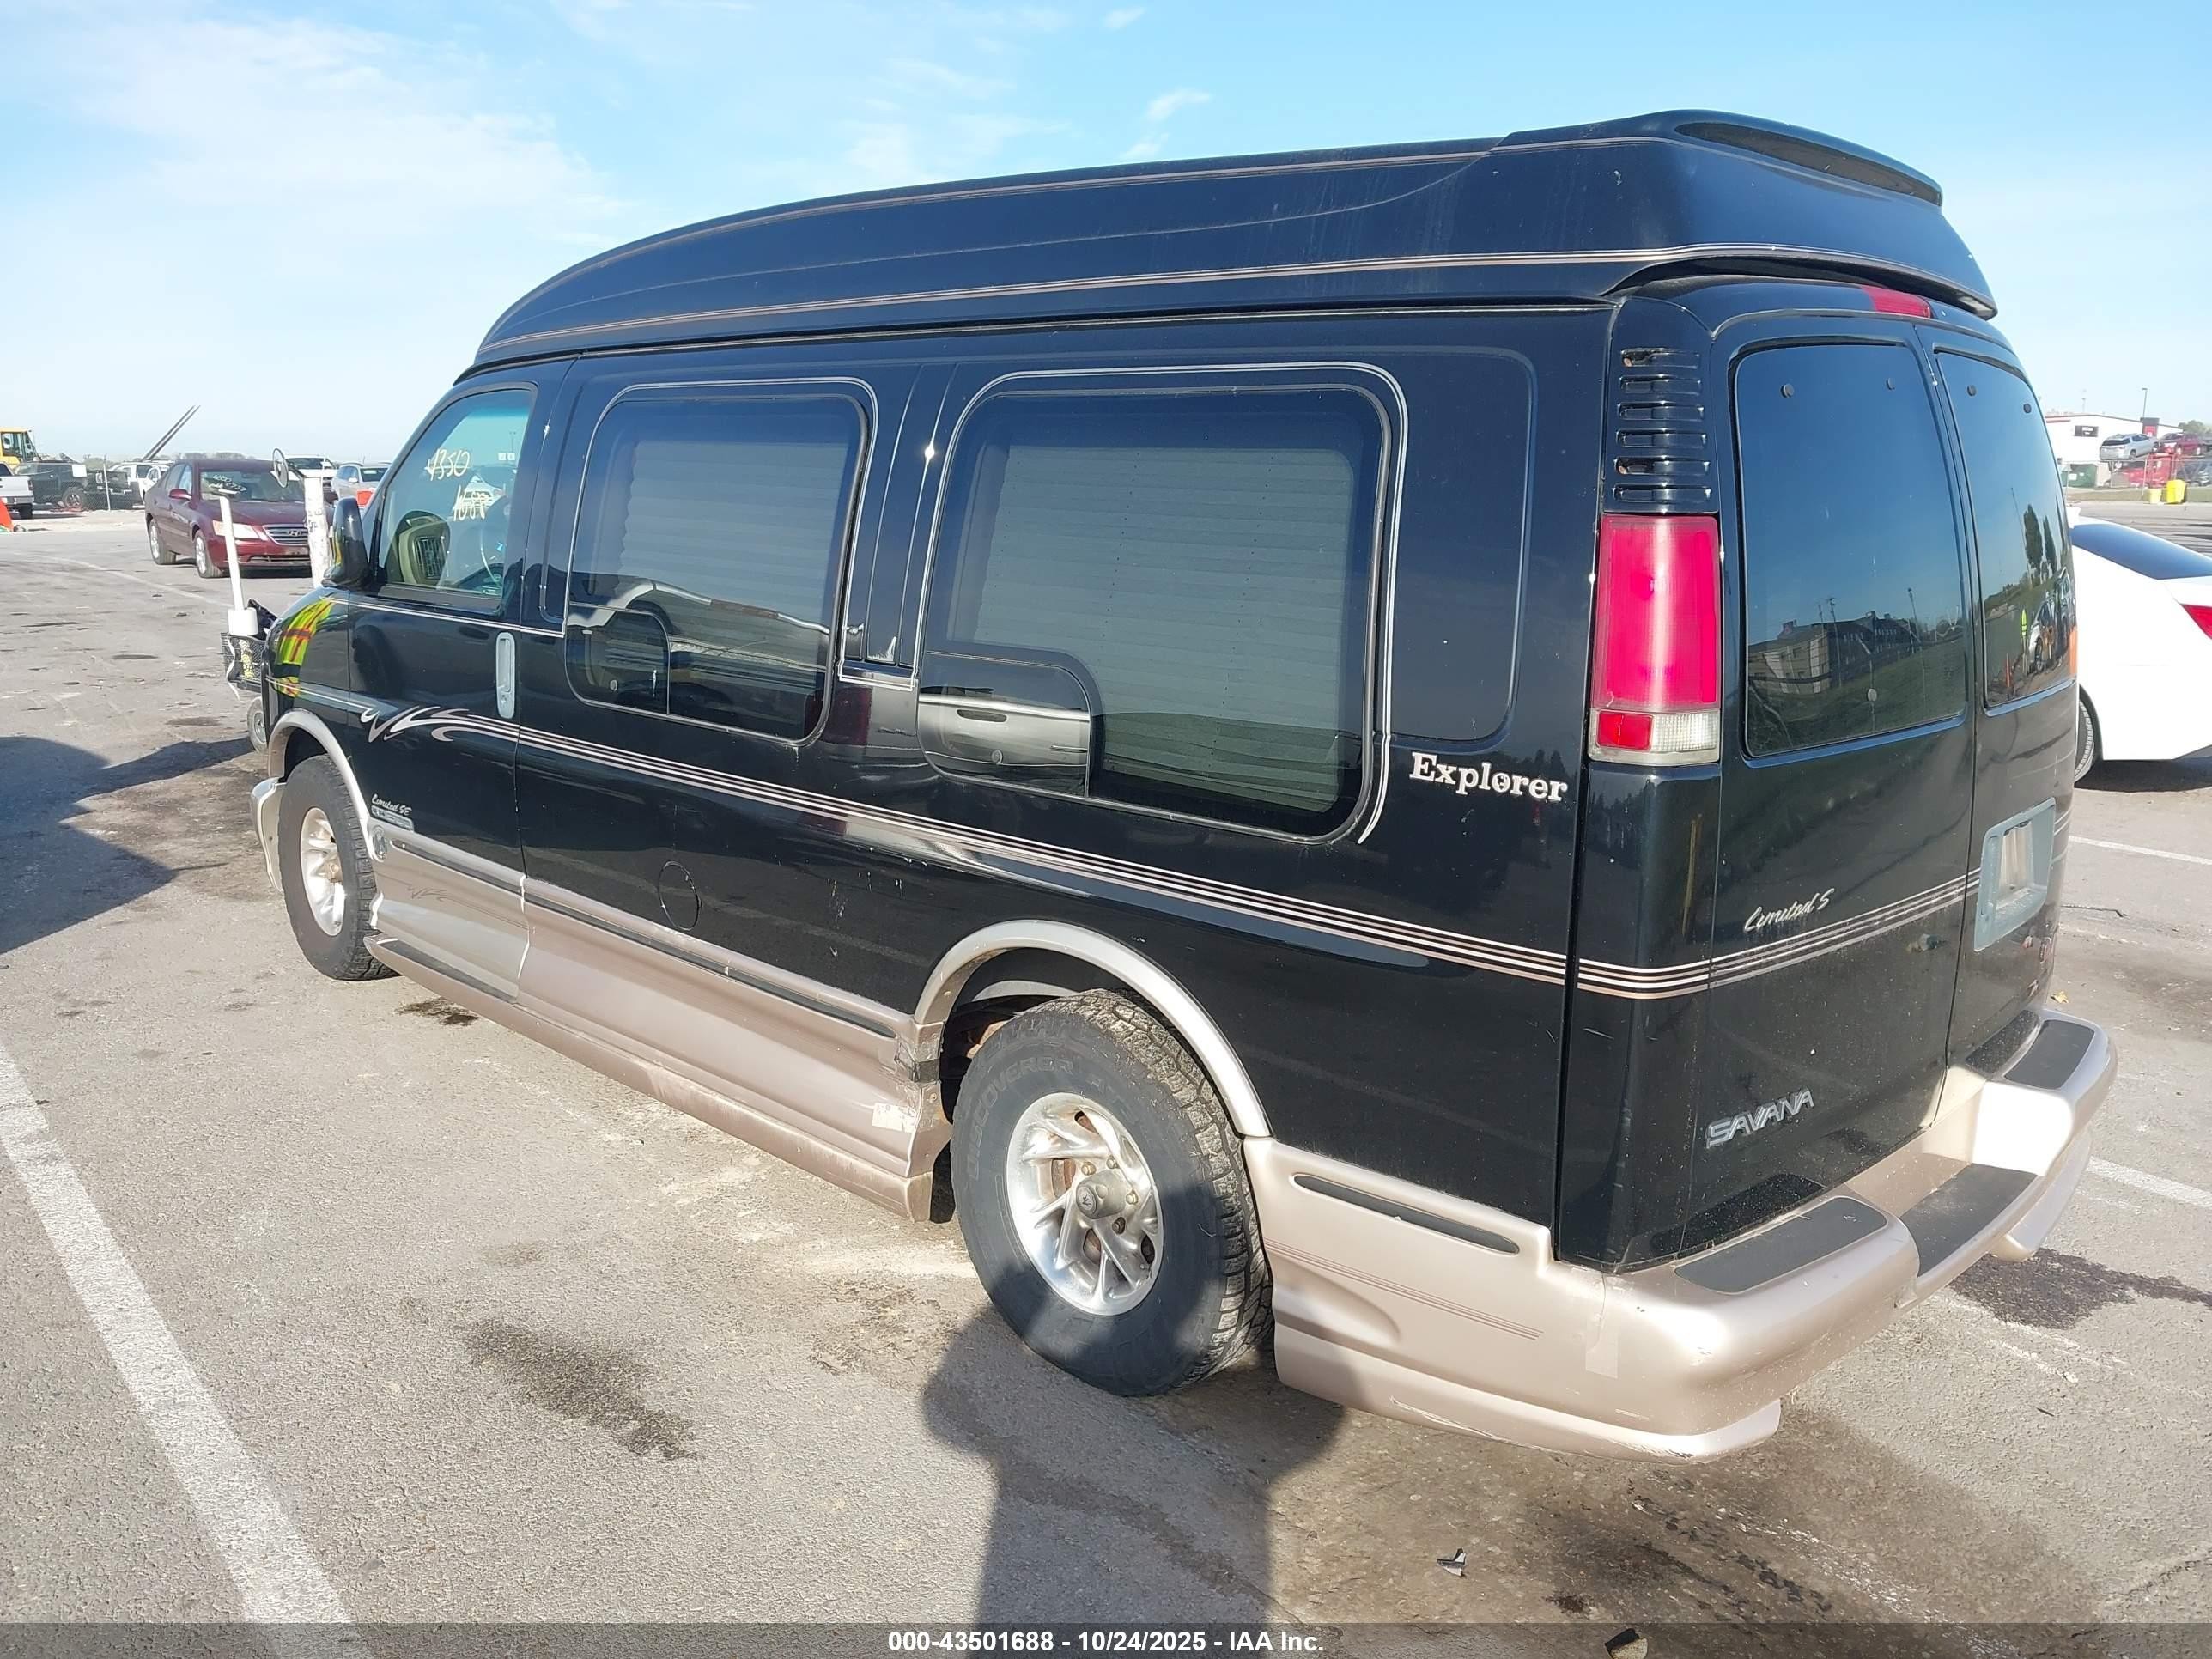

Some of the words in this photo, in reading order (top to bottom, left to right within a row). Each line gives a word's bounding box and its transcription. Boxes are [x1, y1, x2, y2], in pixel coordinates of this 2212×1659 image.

[1409, 751, 1569, 802] Explorer
[371, 793, 401, 812] Limited
[1743, 892, 1820, 933] Limited
[1705, 1086, 1814, 1149] SAVANA
